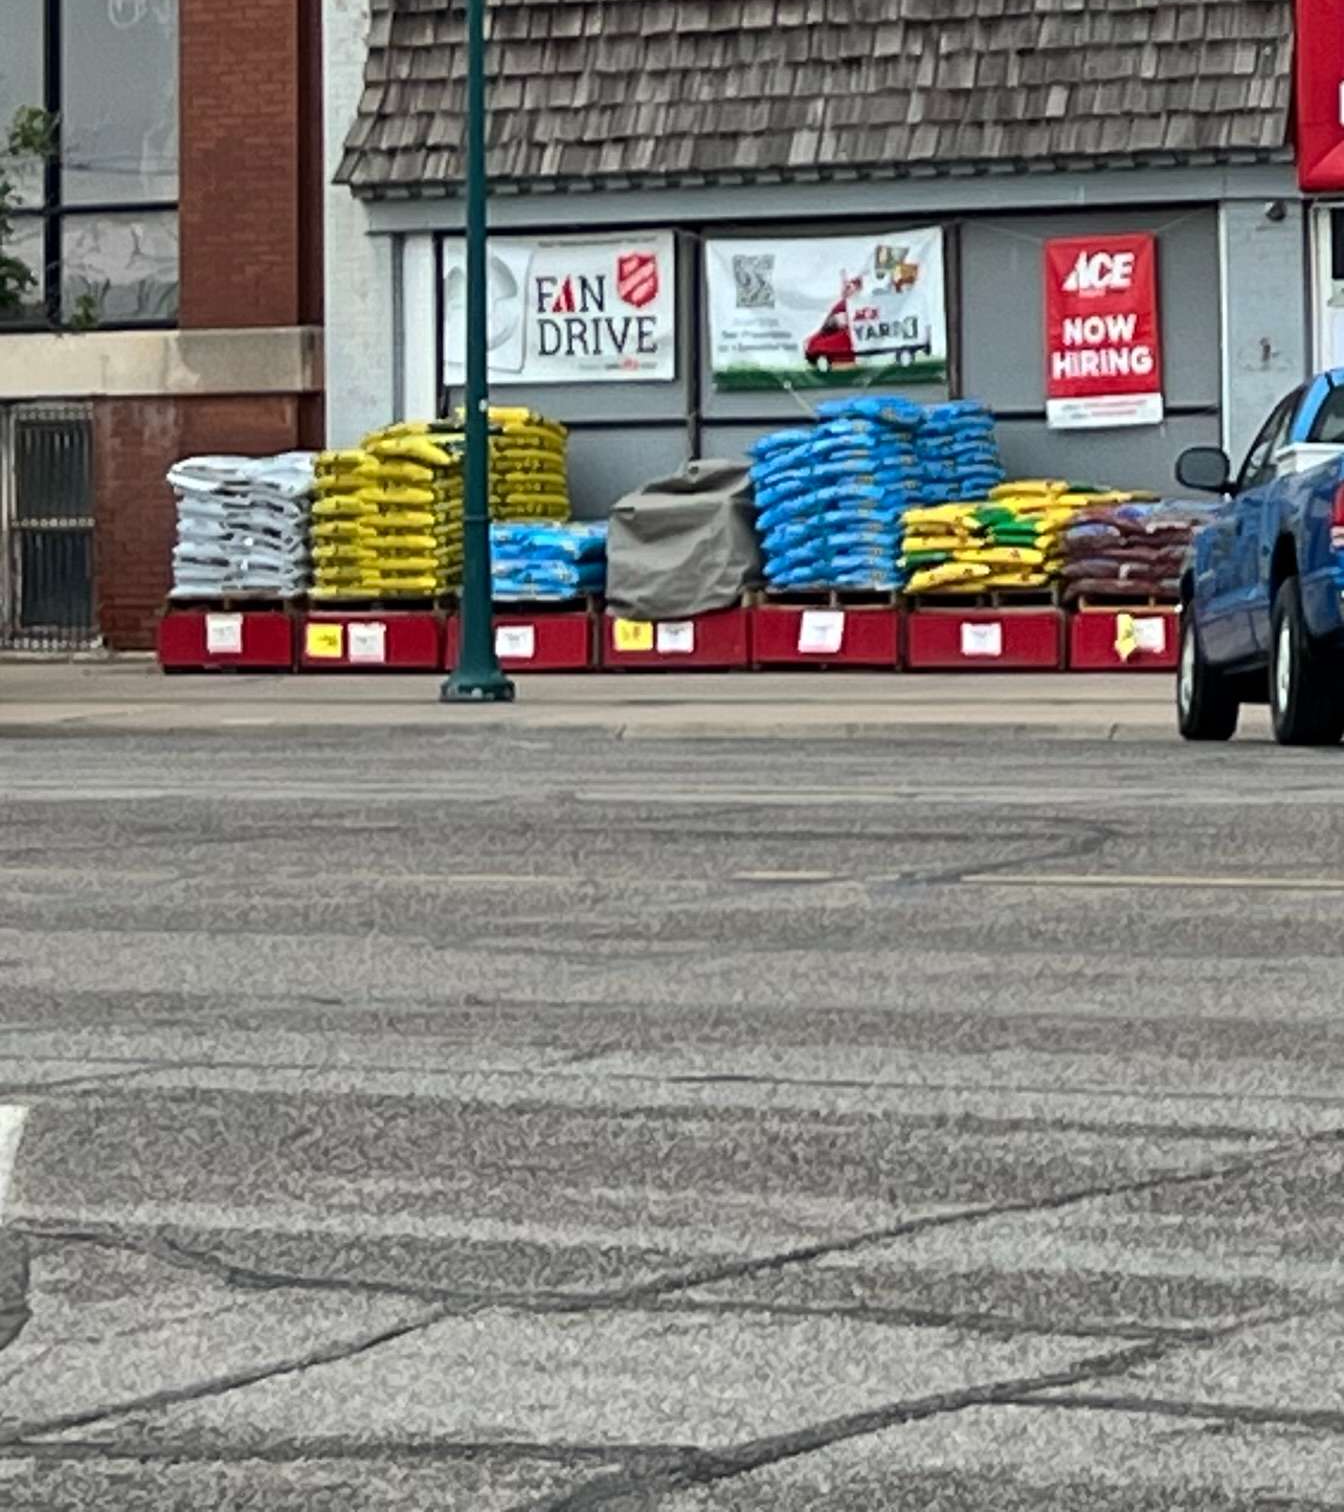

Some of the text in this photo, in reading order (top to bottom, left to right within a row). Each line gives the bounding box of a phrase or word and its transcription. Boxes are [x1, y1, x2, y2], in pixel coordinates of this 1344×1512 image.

[1062, 251, 1134, 291] ACE
[536, 274, 606, 313] FAN
[537, 316, 658, 356] DRIVE
[1063, 314, 1137, 345] NOW
[1052, 346, 1154, 380] HIRING
